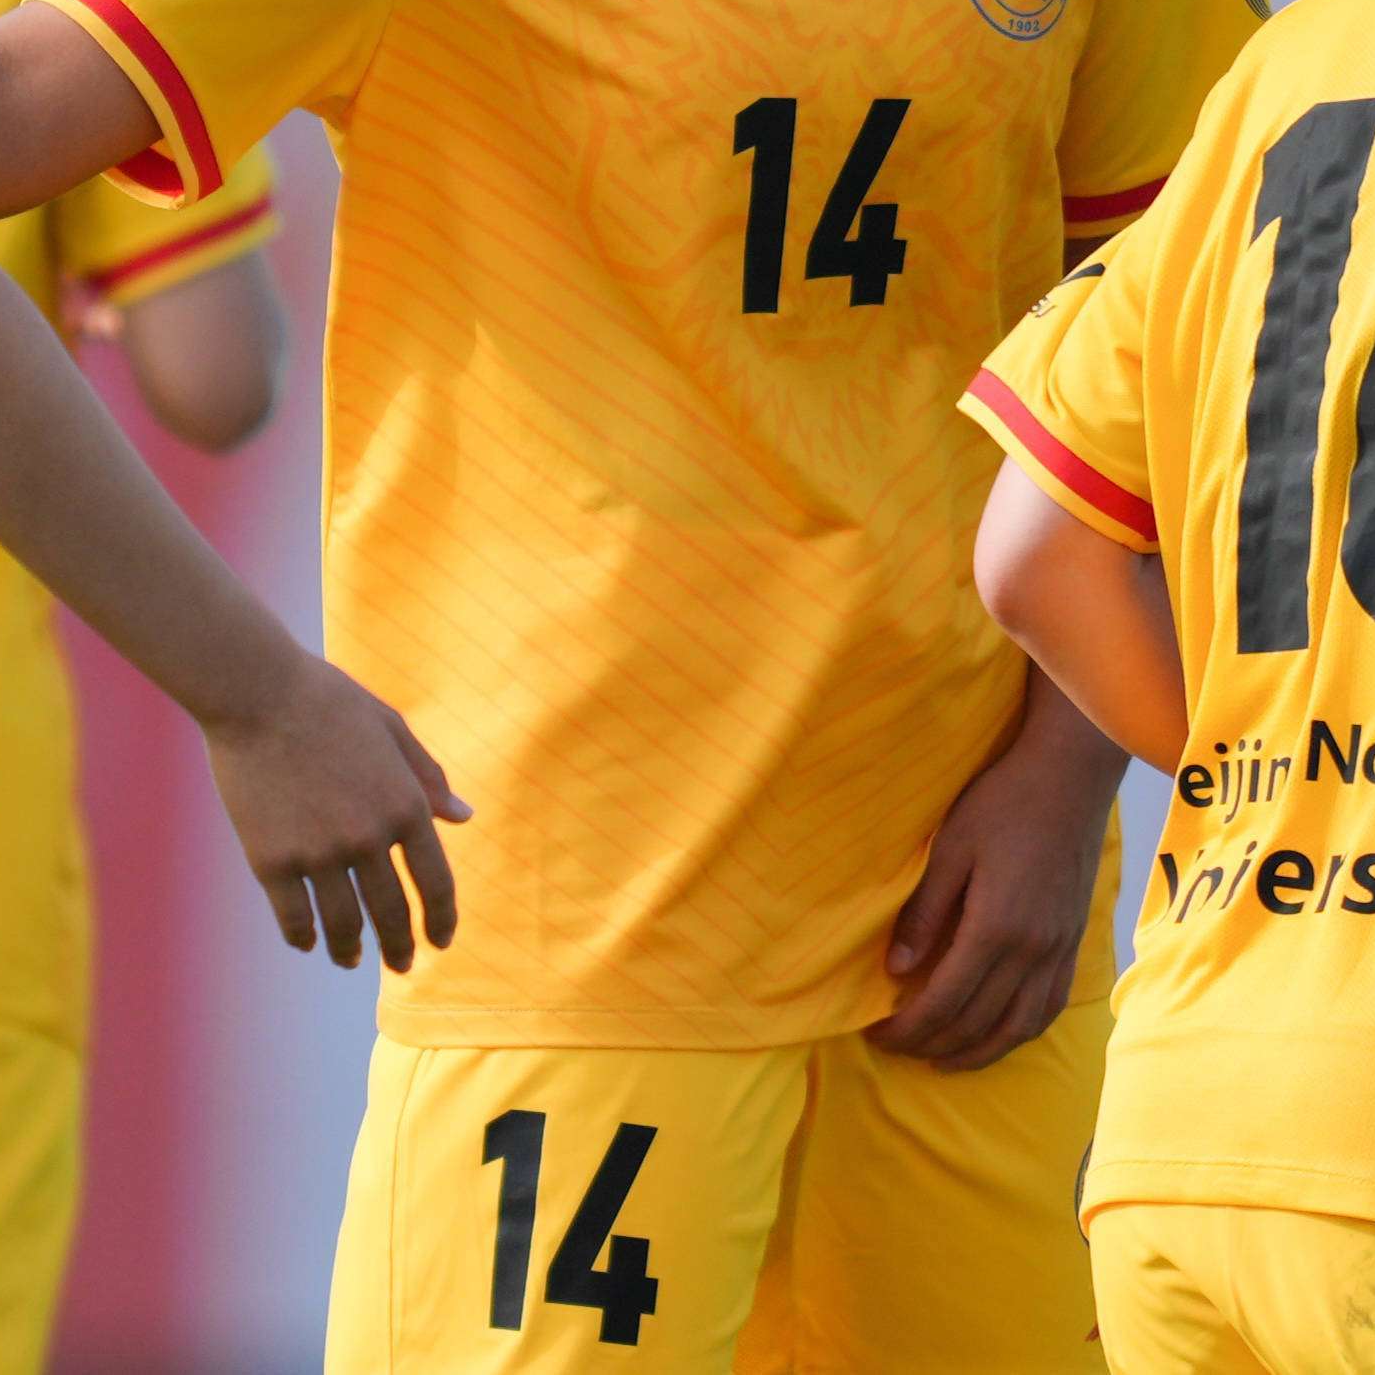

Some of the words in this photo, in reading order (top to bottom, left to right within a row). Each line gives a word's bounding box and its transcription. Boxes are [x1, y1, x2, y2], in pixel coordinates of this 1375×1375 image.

[1008, 18, 1041, 33] 1902
[733, 97, 912, 314] 14
[1178, 739, 1291, 824] eijin
[482, 1109, 659, 1346] 14
